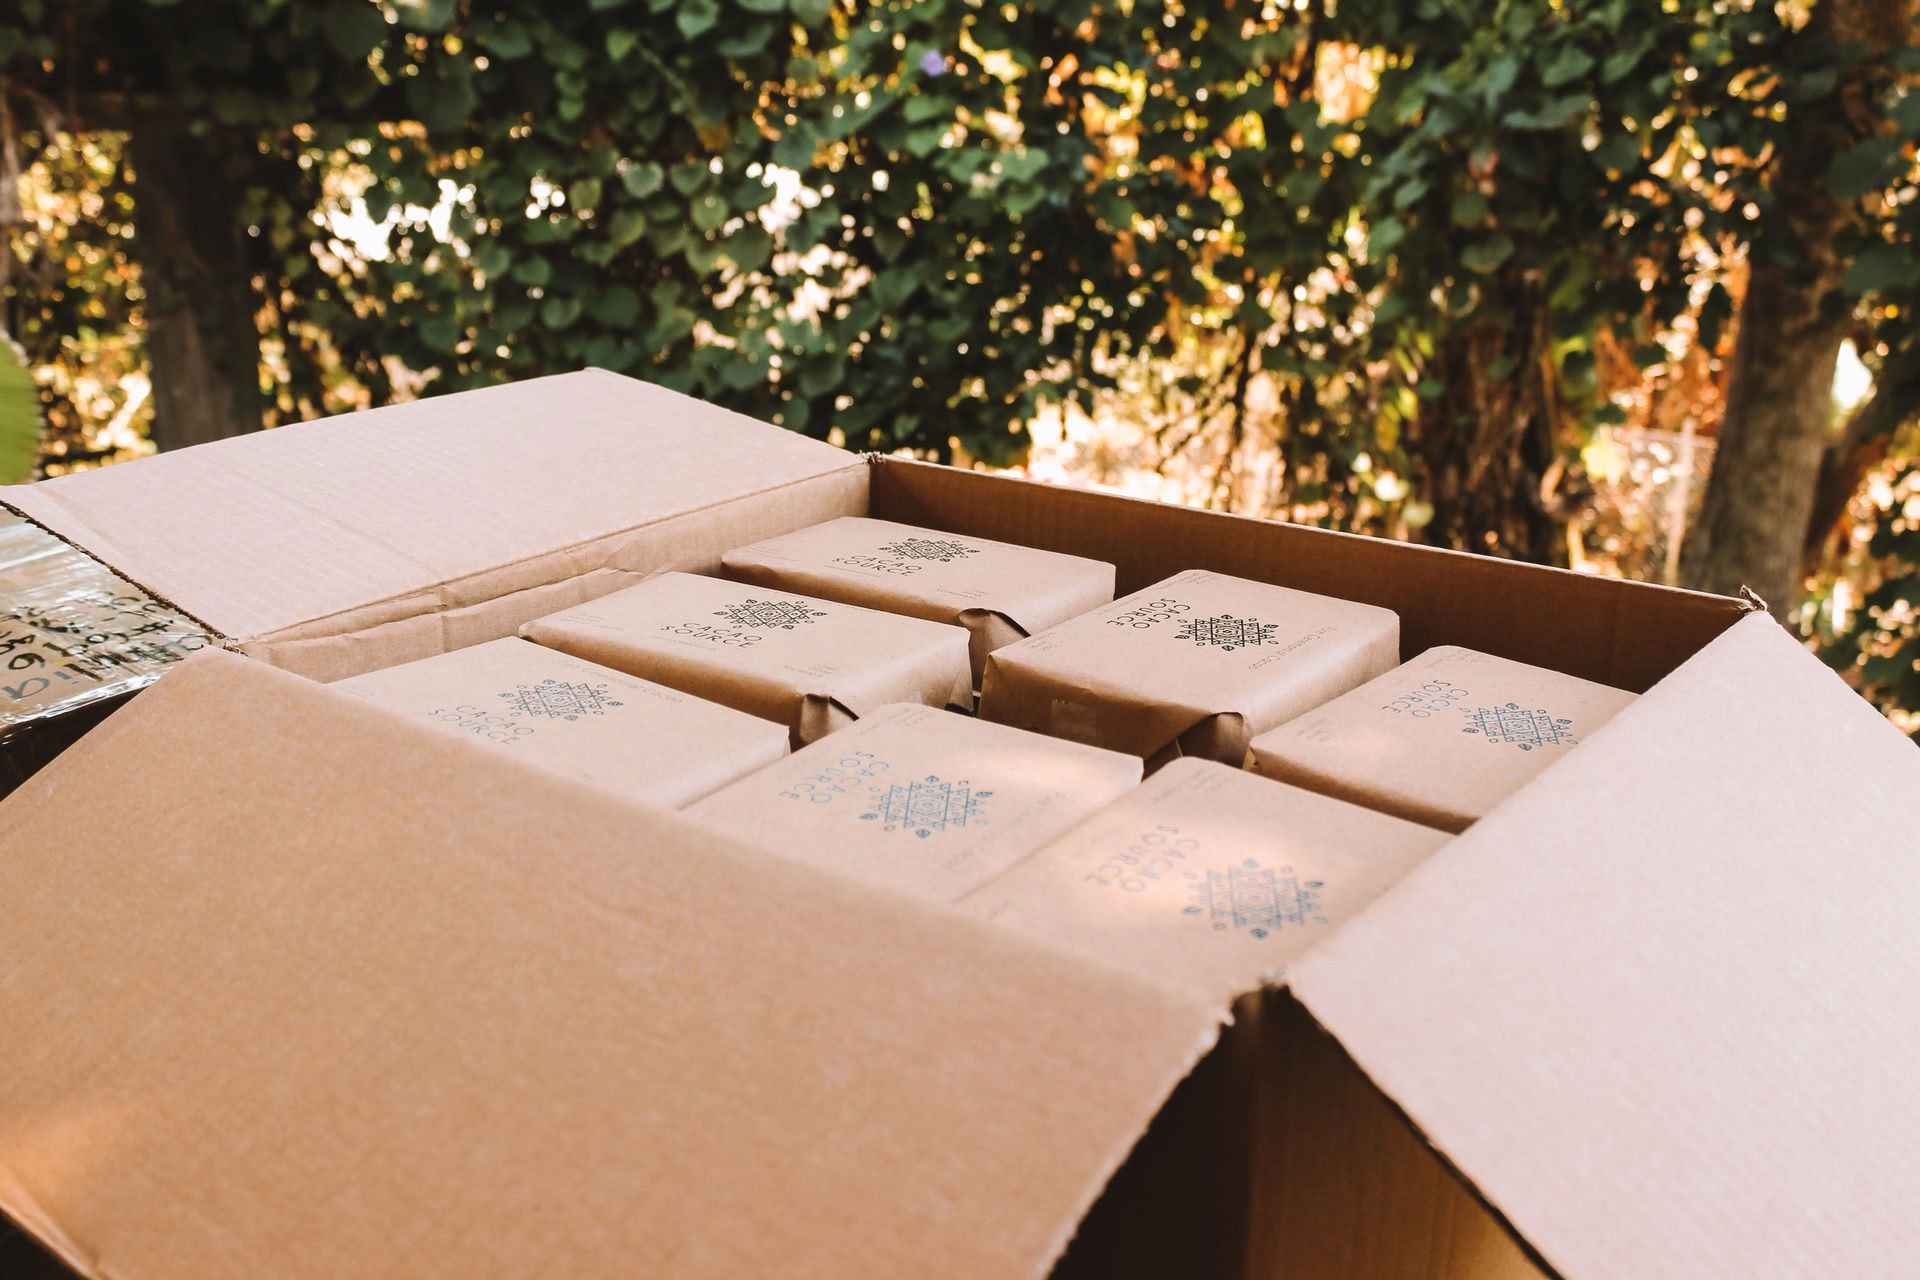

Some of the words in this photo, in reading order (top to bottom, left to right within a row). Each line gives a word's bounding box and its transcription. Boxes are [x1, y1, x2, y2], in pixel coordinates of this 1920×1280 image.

[831, 558, 915, 577] SOURCE
[851, 555, 922, 571] CACAO
[1106, 597, 1177, 626] SOURCE
[1132, 604, 1191, 629] CACAO
[660, 625, 754, 648] SOURCE
[683, 622, 763, 641] CACAO
[1382, 680, 1452, 714] SOURCE
[1411, 688, 1469, 718] CACAO
[428, 710, 521, 745] SOURCE
[456, 705, 535, 736] CACAO
[779, 751, 874, 800] SOURCE
[811, 761, 890, 804] CACAO
[1084, 825, 1179, 888] SOURCE
[1120, 838, 1200, 893] CACAO
